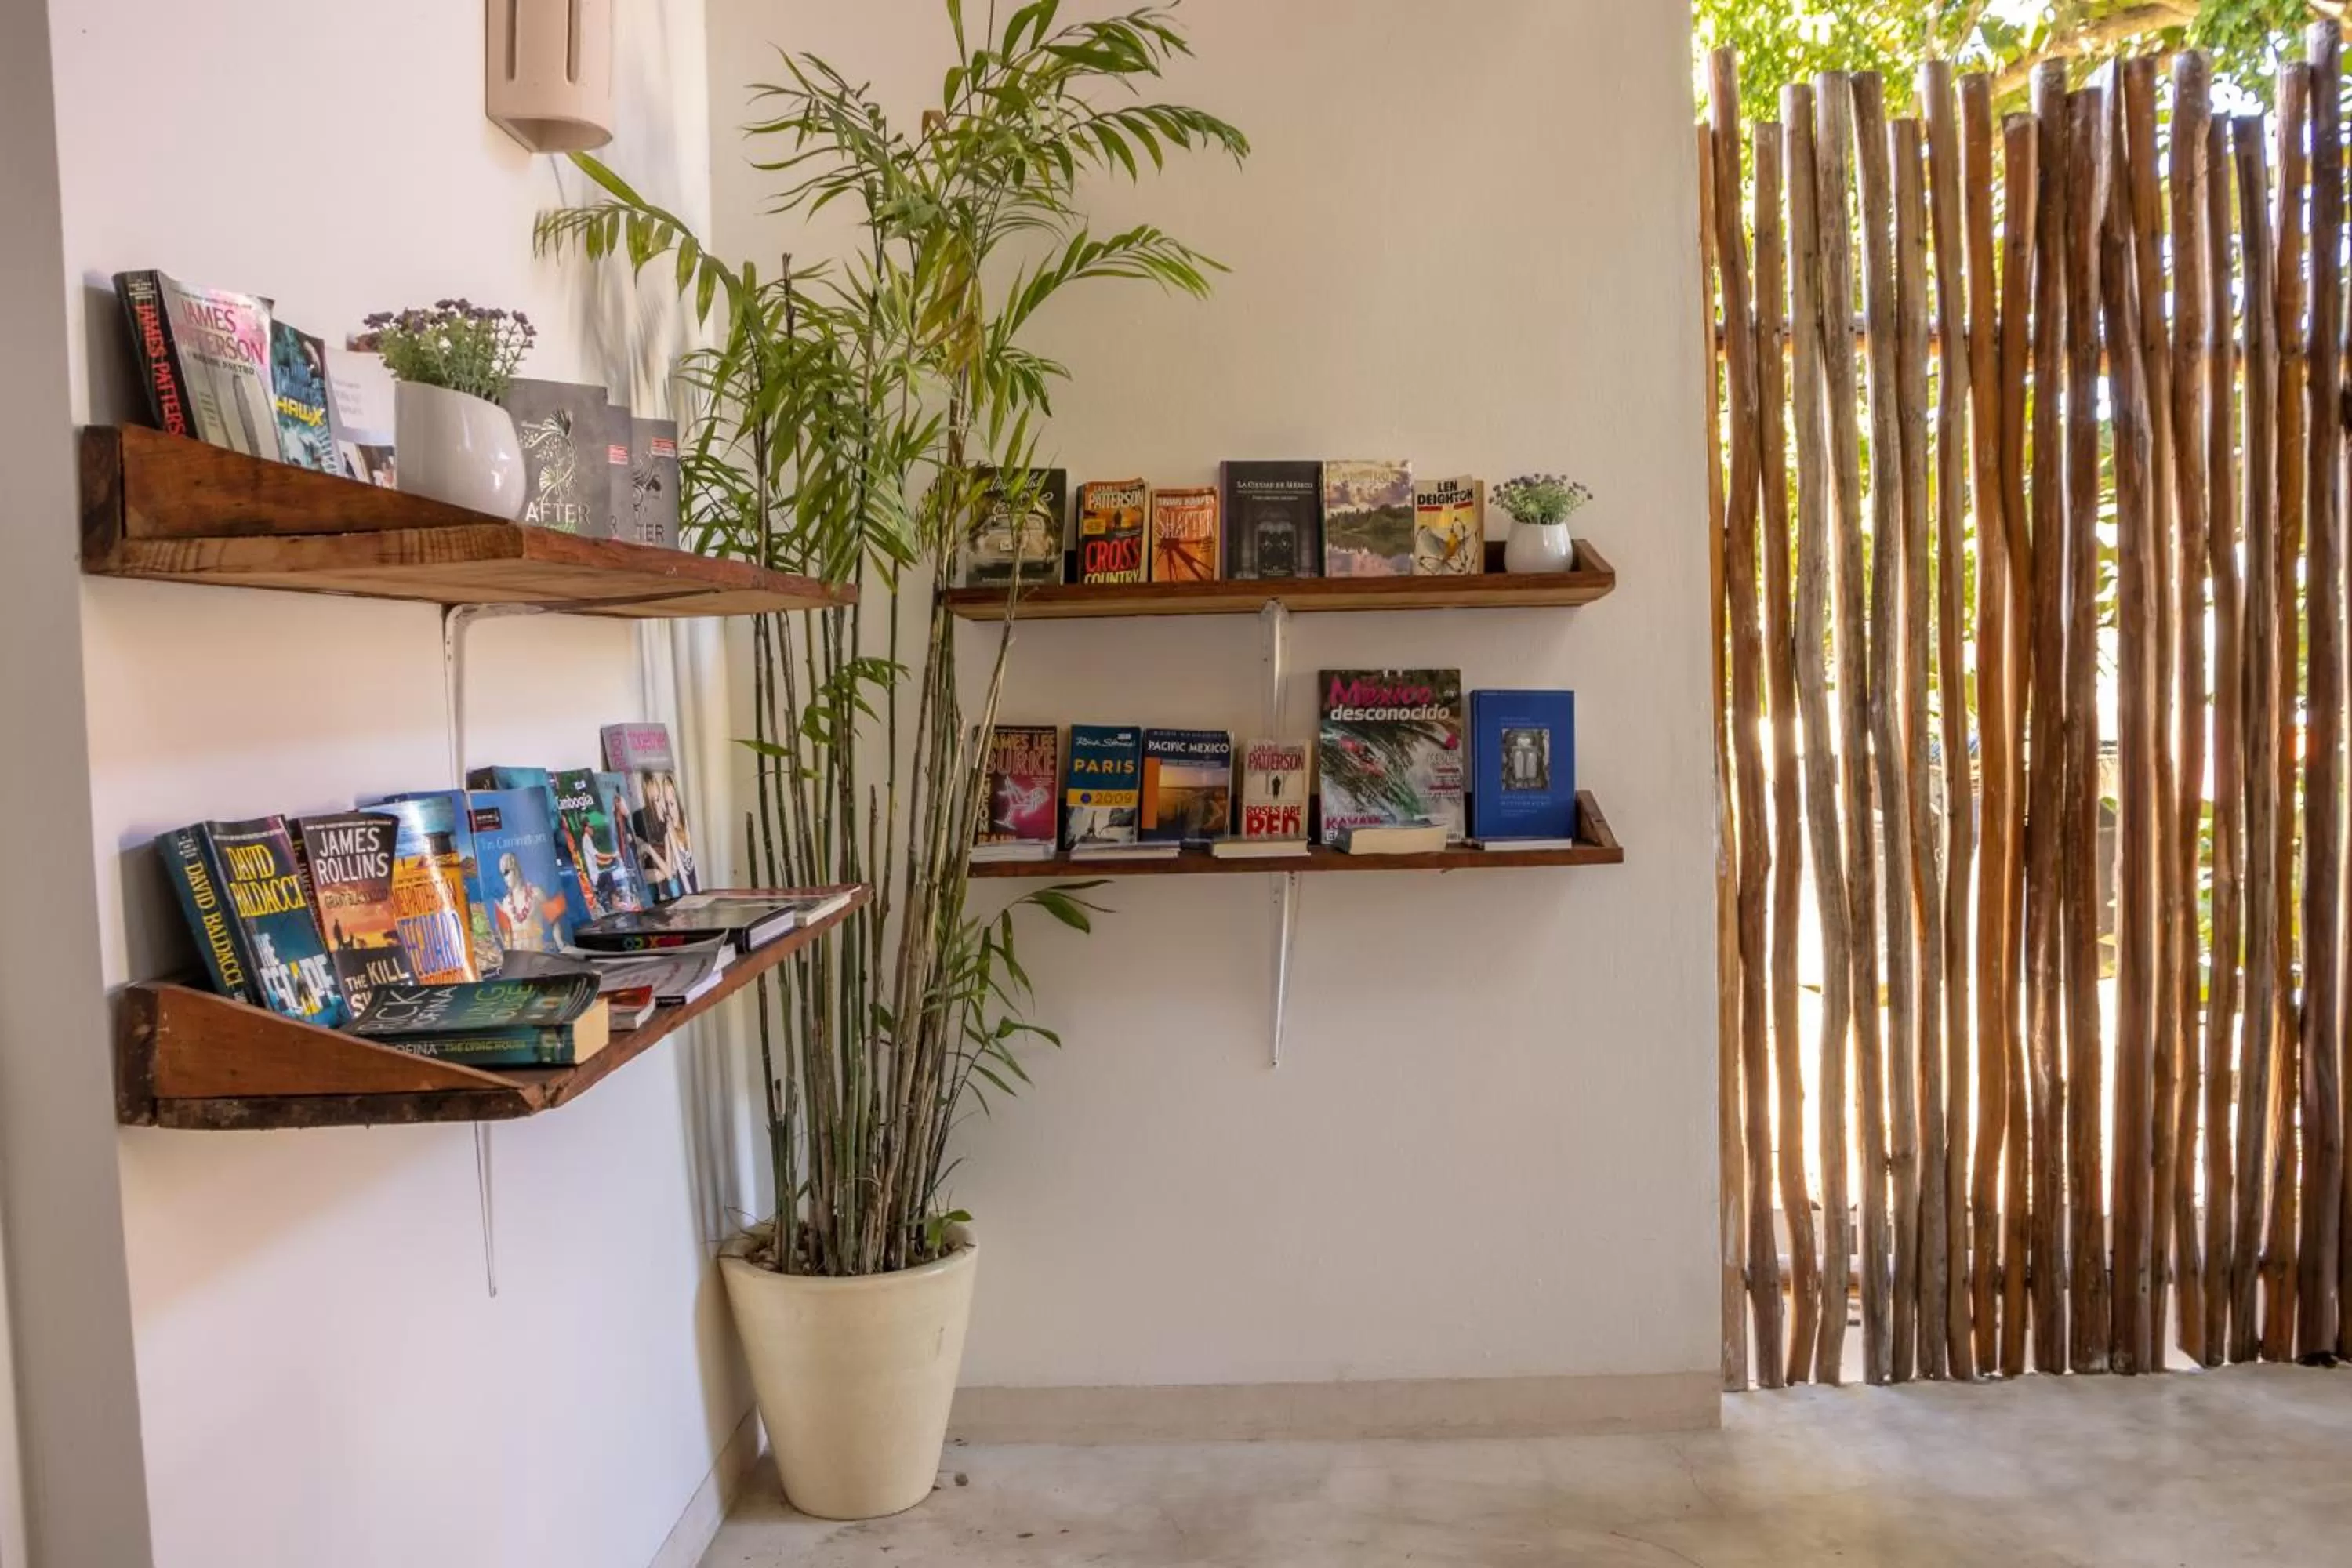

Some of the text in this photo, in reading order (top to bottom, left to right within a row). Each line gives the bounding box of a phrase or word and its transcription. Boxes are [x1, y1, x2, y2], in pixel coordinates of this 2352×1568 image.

[134, 303, 168, 358] JAMES
[152, 360, 187, 436] PATTERS
[1417, 488, 1473, 505] DEIGHTON
[1437, 480, 1457, 493] LEN
[1088, 488, 1144, 510] PATTERSON
[524, 501, 590, 524] AFTER
[1156, 508, 1215, 539] SHATTER
[1084, 537, 1142, 574] CROSS
[1330, 704, 1450, 721] desconocido
[992, 734, 1054, 750] AMES LEE
[1147, 739, 1229, 753] PACIFIC MEXICO
[1073, 758, 1134, 774] PARIS
[1248, 752, 1305, 771] PATTERSON
[1094, 792, 1133, 804] 2009
[1247, 805, 1301, 816] ROSES ARE
[1246, 815, 1301, 834] RED
[319, 827, 381, 858] JAMES
[226, 844, 276, 880] DAVID
[316, 852, 389, 885] ROLLINS
[230, 875, 307, 918] BALDACCI
[185, 862, 216, 909] DAVID
[203, 911, 245, 988] BALDACCI
[345, 977, 367, 991] THE
[366, 958, 408, 985] KILL
